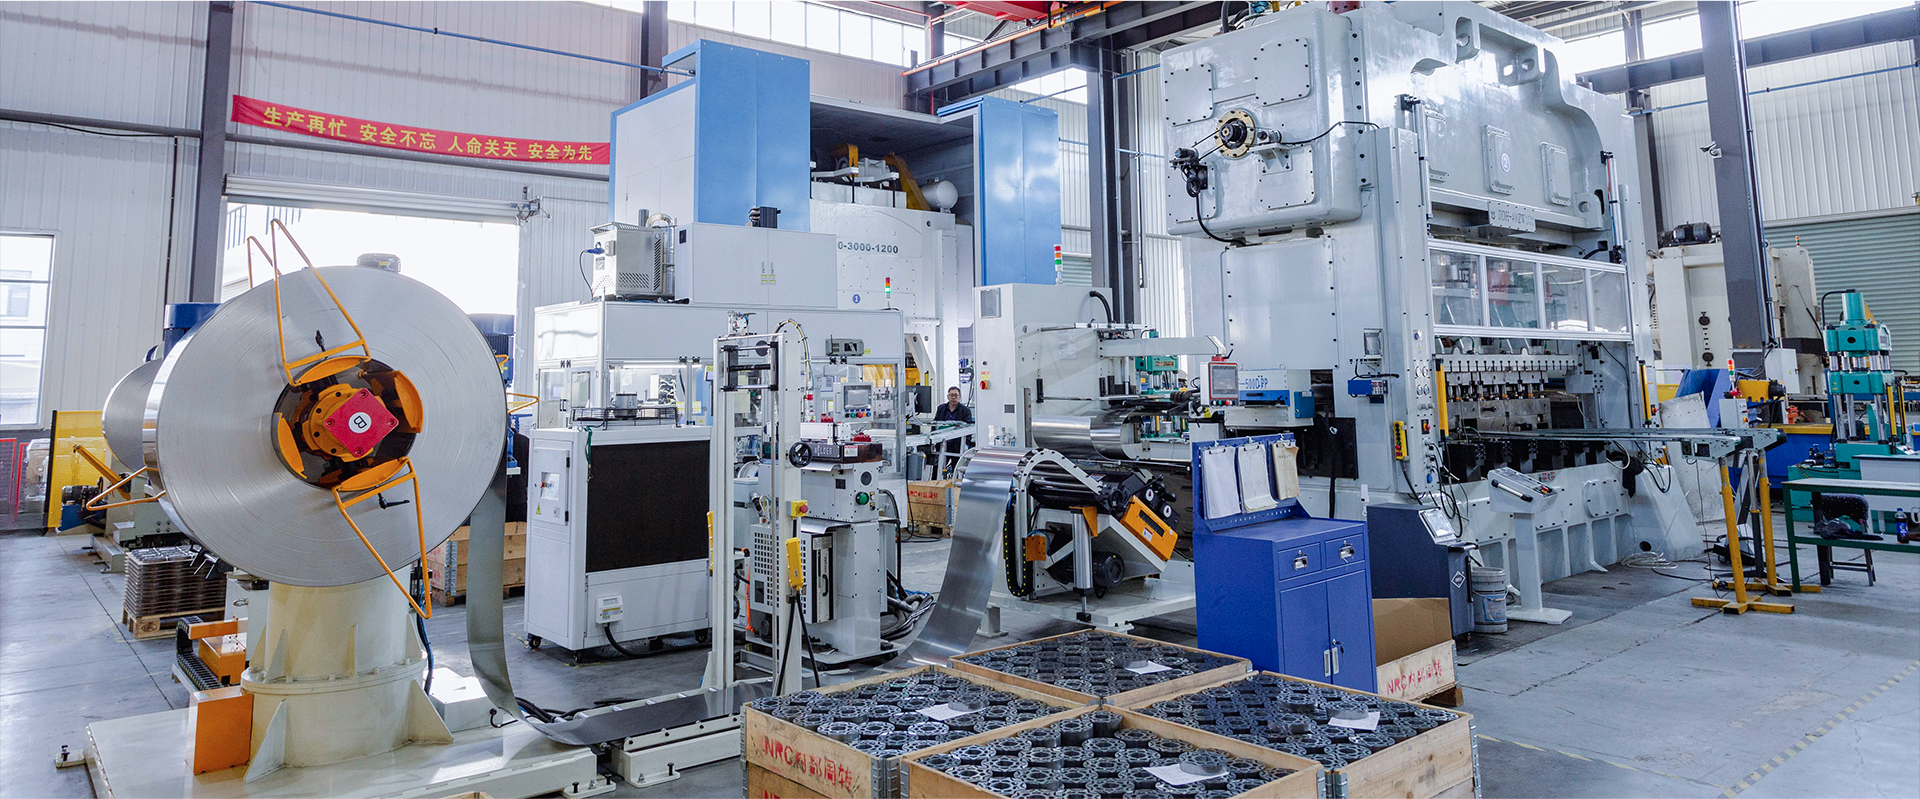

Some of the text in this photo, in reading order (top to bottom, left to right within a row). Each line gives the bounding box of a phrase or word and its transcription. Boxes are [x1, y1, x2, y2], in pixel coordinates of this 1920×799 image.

[263, 106, 593, 162] 生产再忙 安全不忘 人命关天 安全为先
[837, 240, 899, 254] 0-3000-1200
[353, 415, 368, 429] B
[763, 735, 853, 794] NRC内部周转
